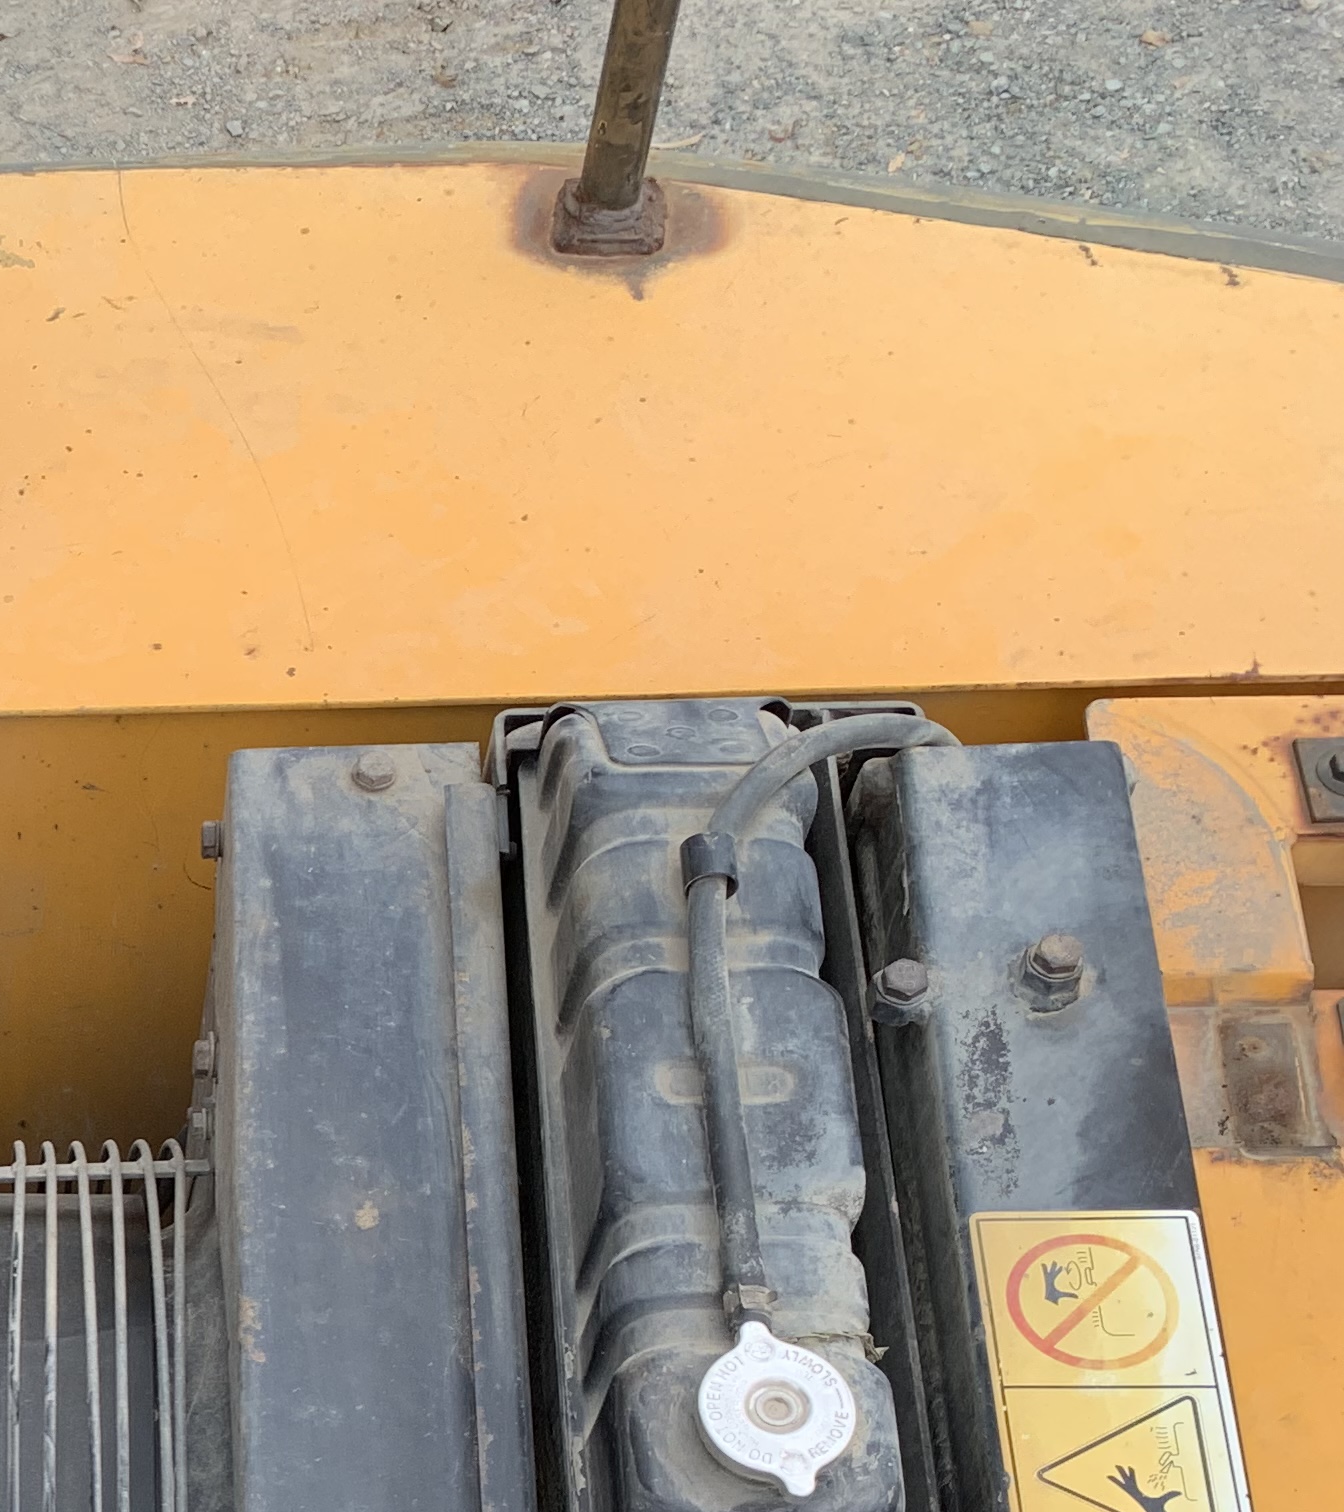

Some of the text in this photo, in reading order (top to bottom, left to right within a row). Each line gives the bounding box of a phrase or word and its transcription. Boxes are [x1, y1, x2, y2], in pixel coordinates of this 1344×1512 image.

[706, 1381, 723, 1421] OPEN
[781, 1348, 849, 1459] REMOVE SLOWLY
[716, 1426, 746, 1452] NOT
[749, 1448, 773, 1464] DO
